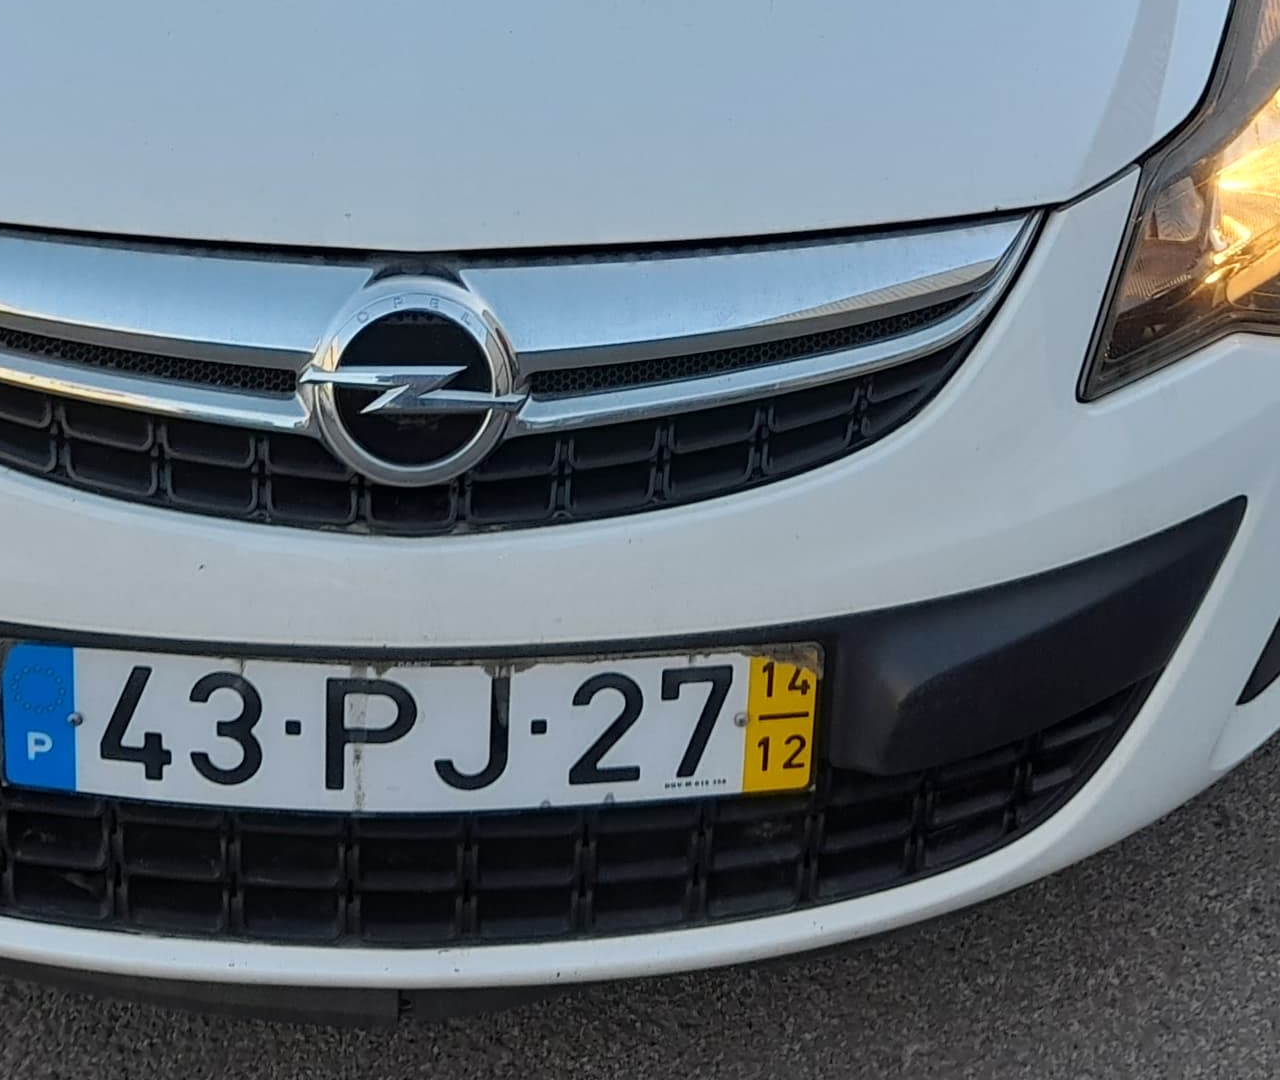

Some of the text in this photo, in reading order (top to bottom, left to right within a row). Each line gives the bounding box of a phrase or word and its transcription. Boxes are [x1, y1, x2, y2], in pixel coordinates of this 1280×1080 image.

[762, 661, 811, 697] 14
[27, 731, 53, 761] P
[757, 734, 807, 772] 12
